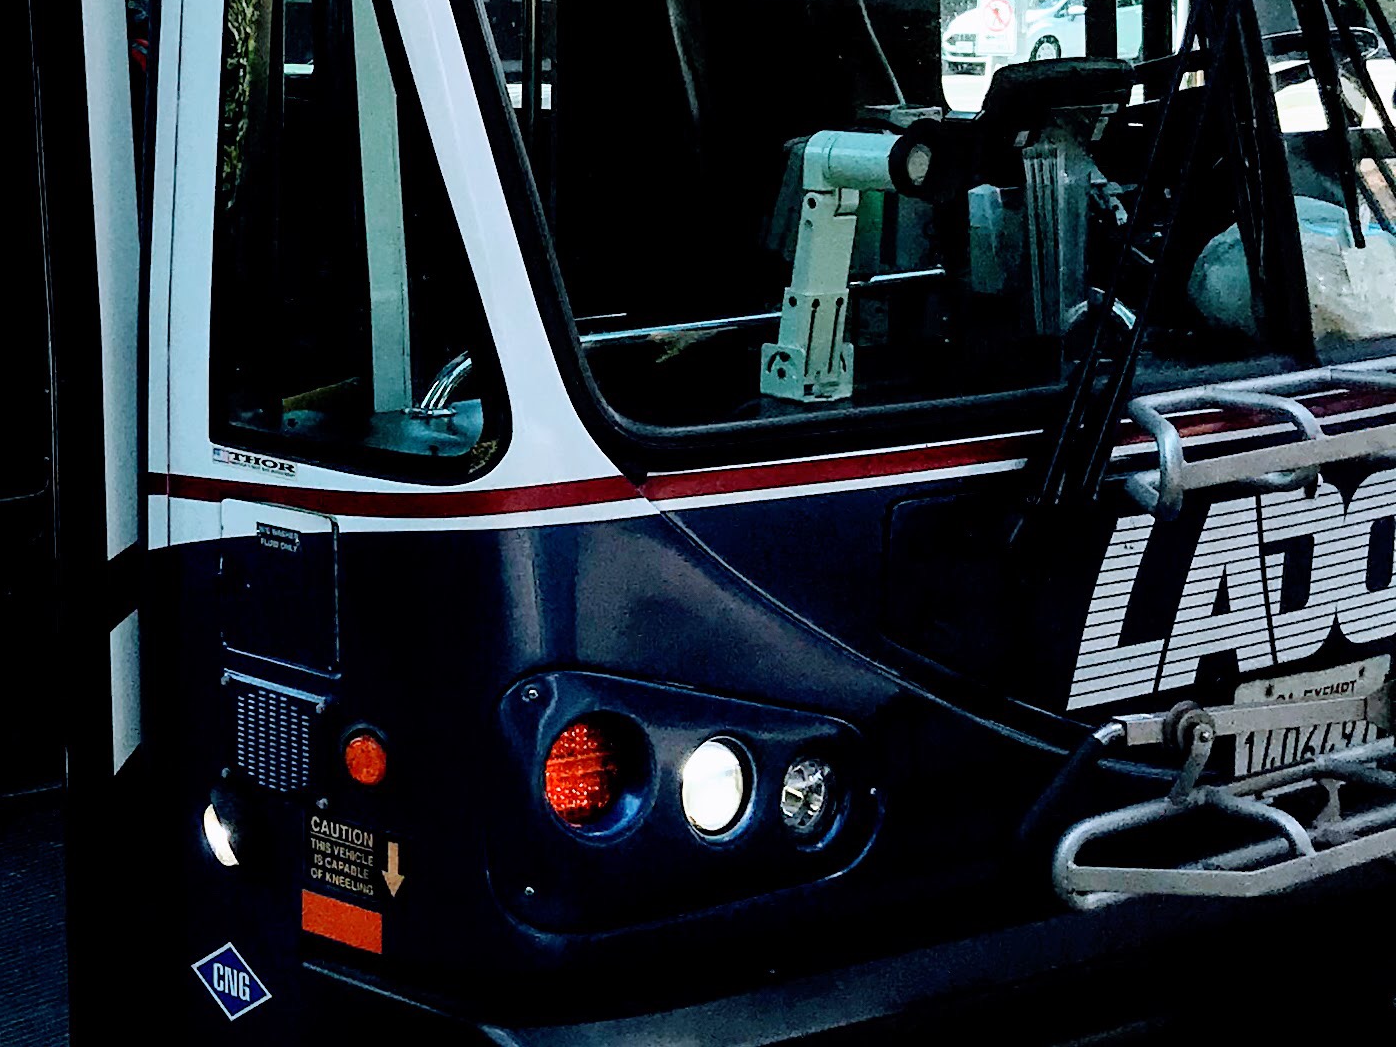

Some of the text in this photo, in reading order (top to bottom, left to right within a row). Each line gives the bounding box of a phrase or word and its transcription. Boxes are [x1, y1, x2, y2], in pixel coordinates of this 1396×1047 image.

[228, 451, 296, 473] THOR
[1066, 468, 1396, 711] LADO
[310, 816, 373, 847] CAUTION
[310, 837, 374, 867] THIS VEHICLE
[314, 853, 369, 880] IS CAPABLE
[310, 867, 374, 896] OF KNEELING
[212, 962, 251, 1002] CNG
